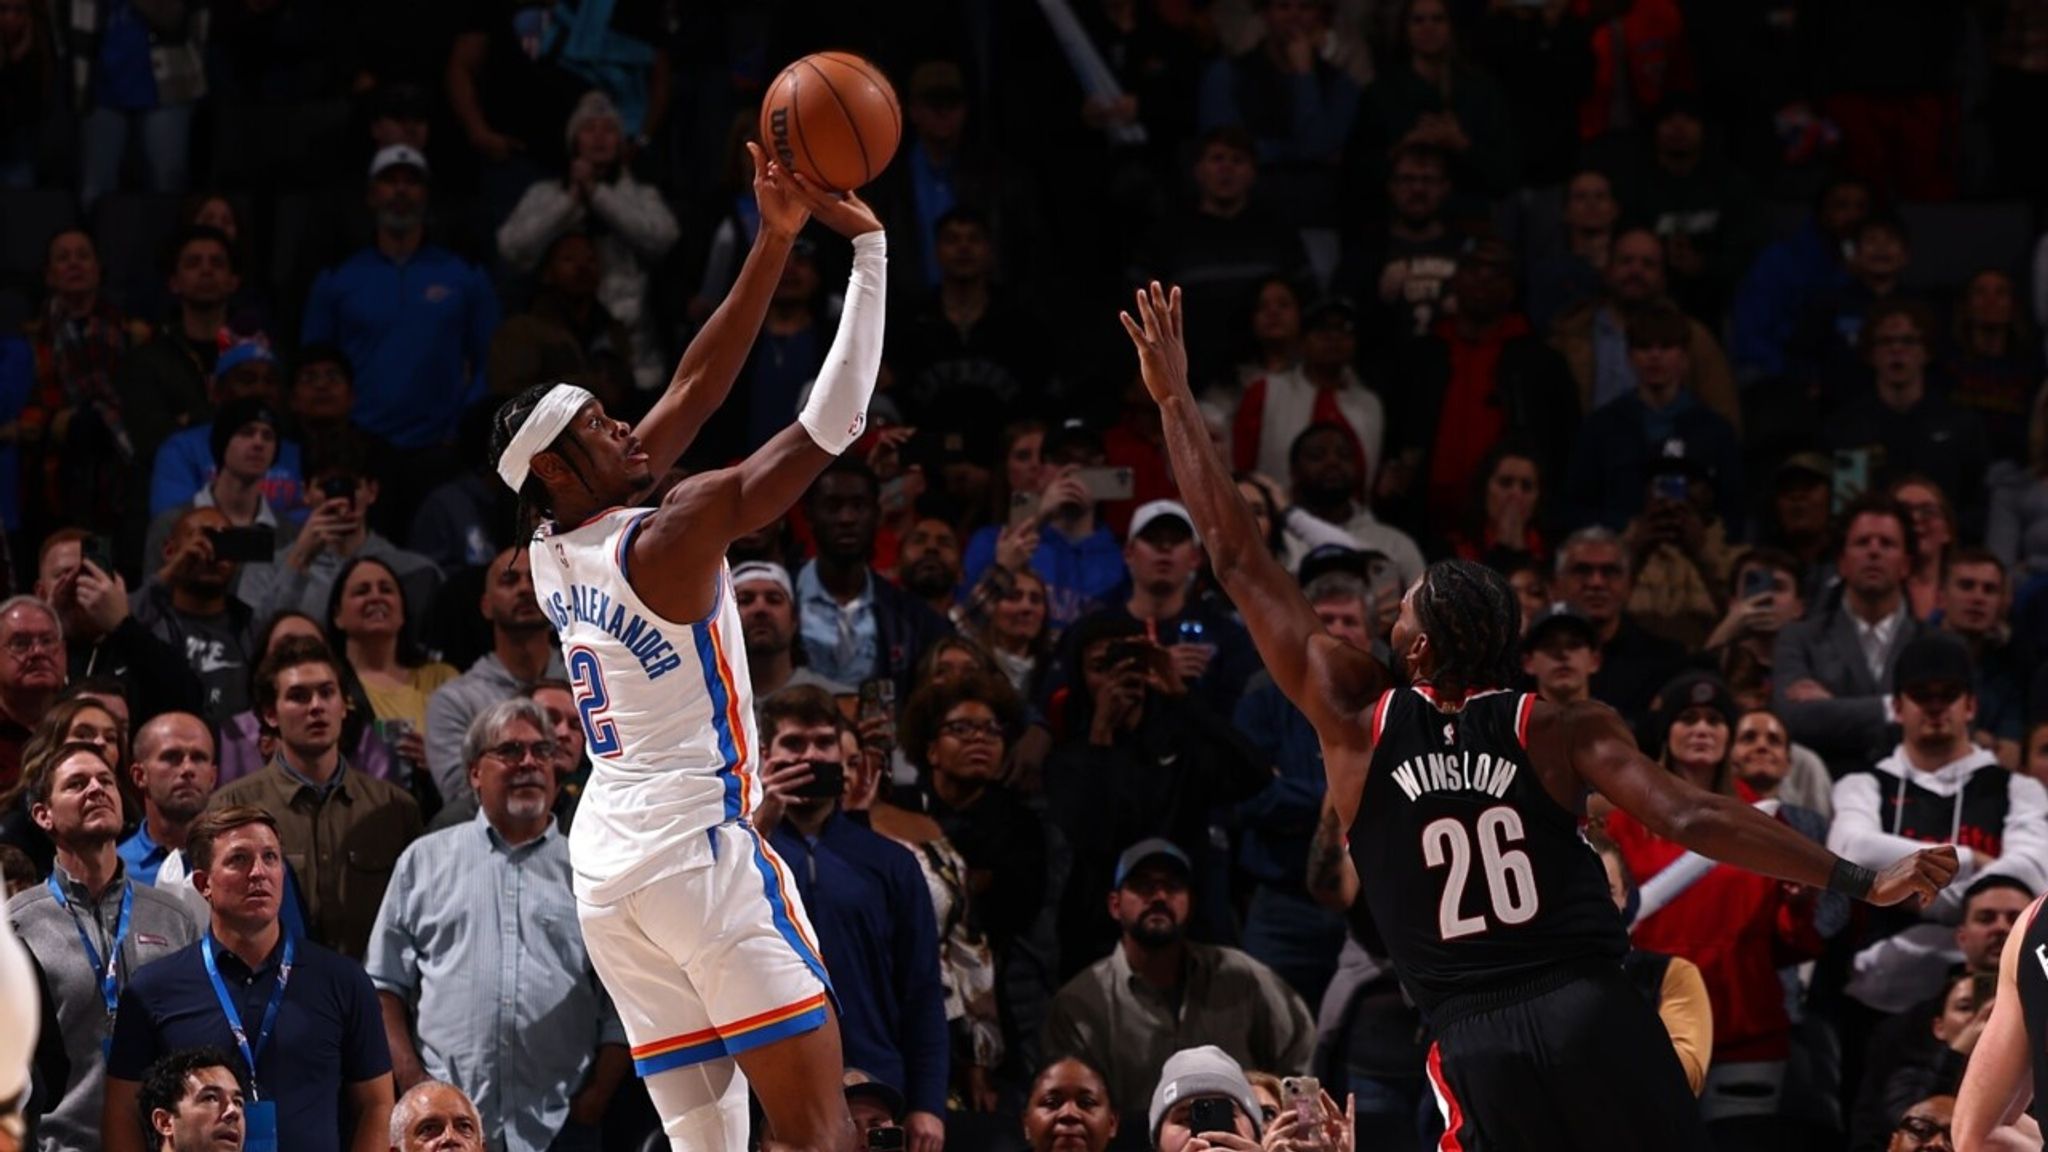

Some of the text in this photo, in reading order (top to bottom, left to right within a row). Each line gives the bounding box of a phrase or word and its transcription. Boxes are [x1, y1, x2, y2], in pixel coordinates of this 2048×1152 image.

[568, 645, 623, 759] 2
[1391, 751, 1517, 802] WINSLOW
[1421, 805, 1540, 941] 26
